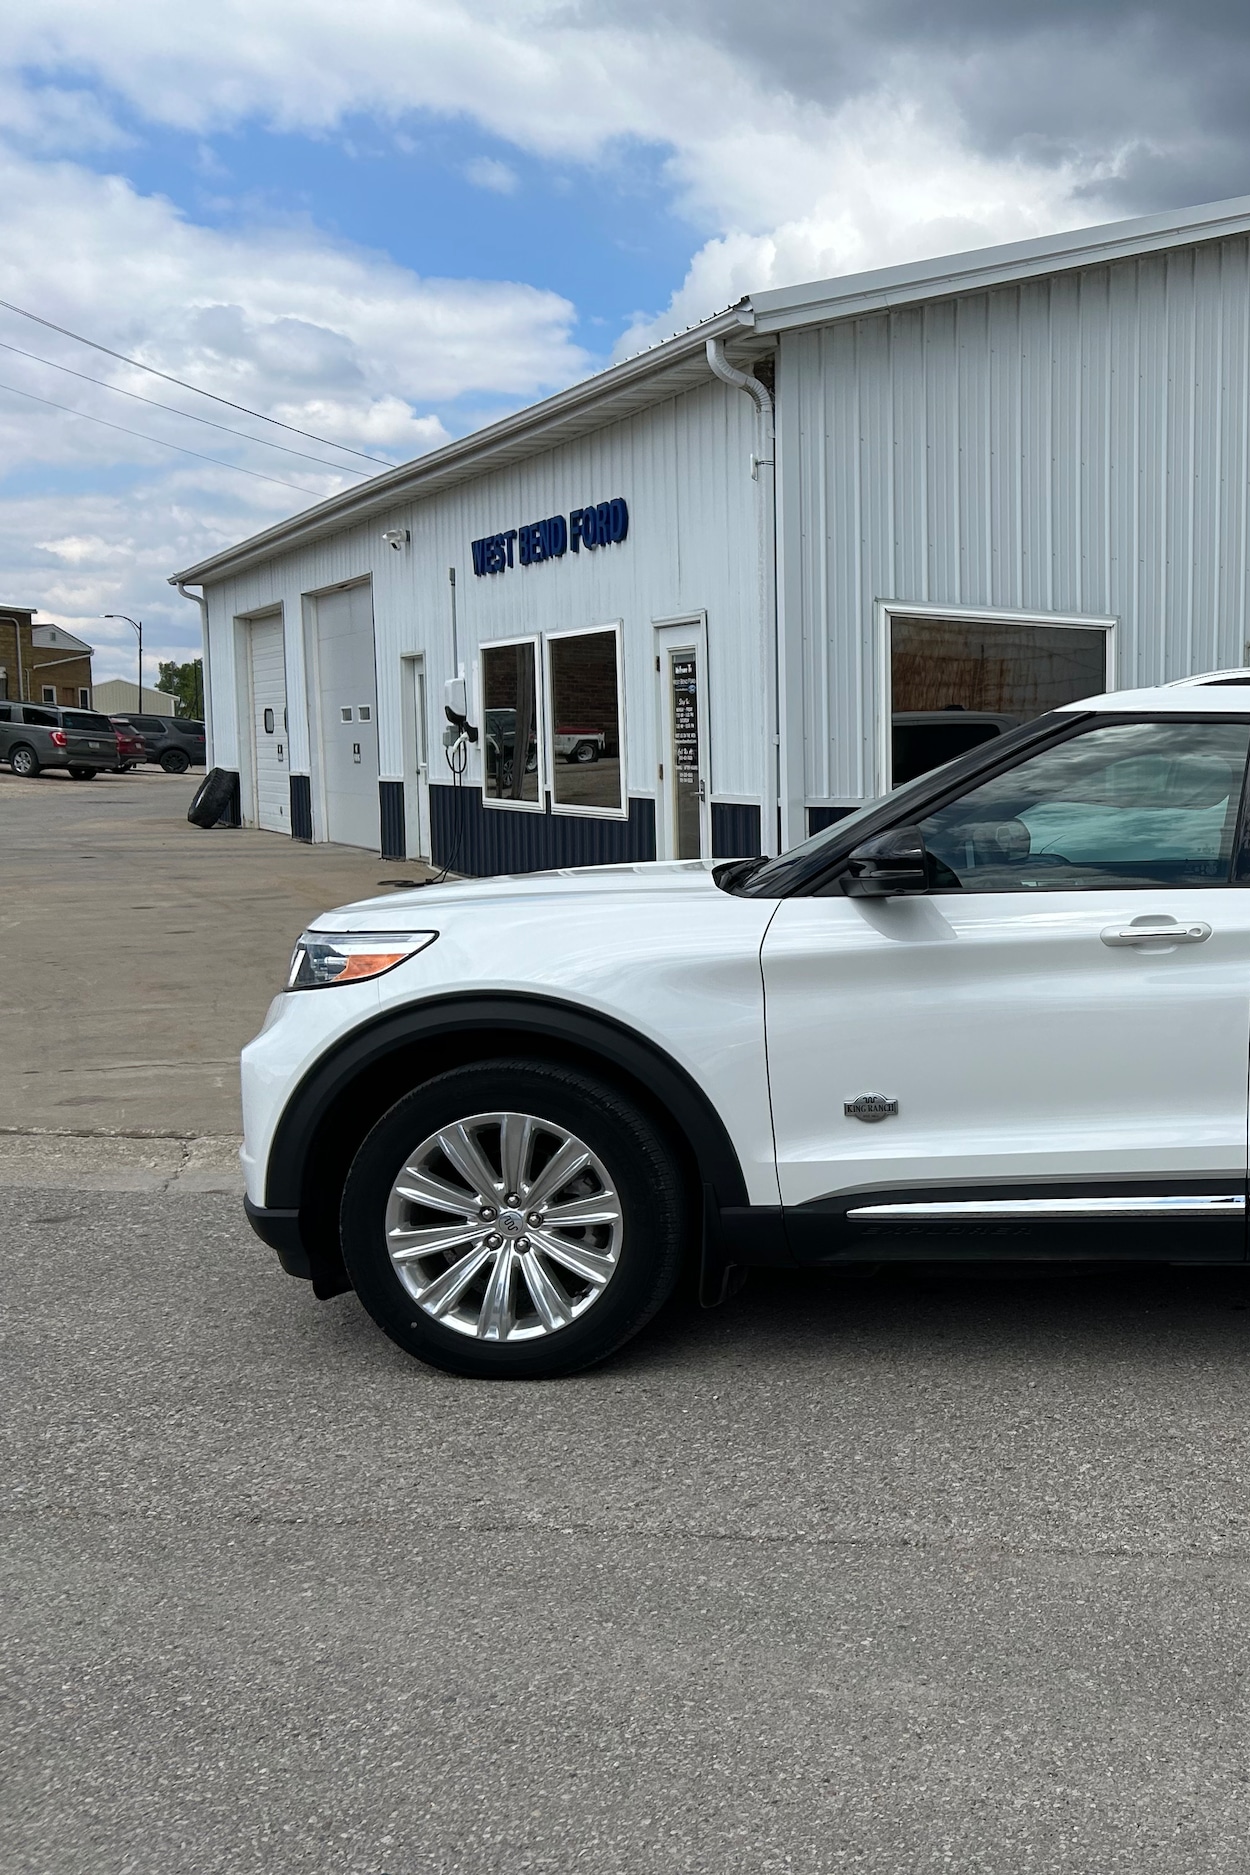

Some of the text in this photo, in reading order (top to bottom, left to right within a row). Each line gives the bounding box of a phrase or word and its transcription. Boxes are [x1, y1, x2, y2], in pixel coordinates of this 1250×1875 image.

[471, 497, 629, 577] WEST BEND FORD
[847, 1103, 894, 1113] KING RANCH
[861, 1226, 1033, 1236] EXPLORER
